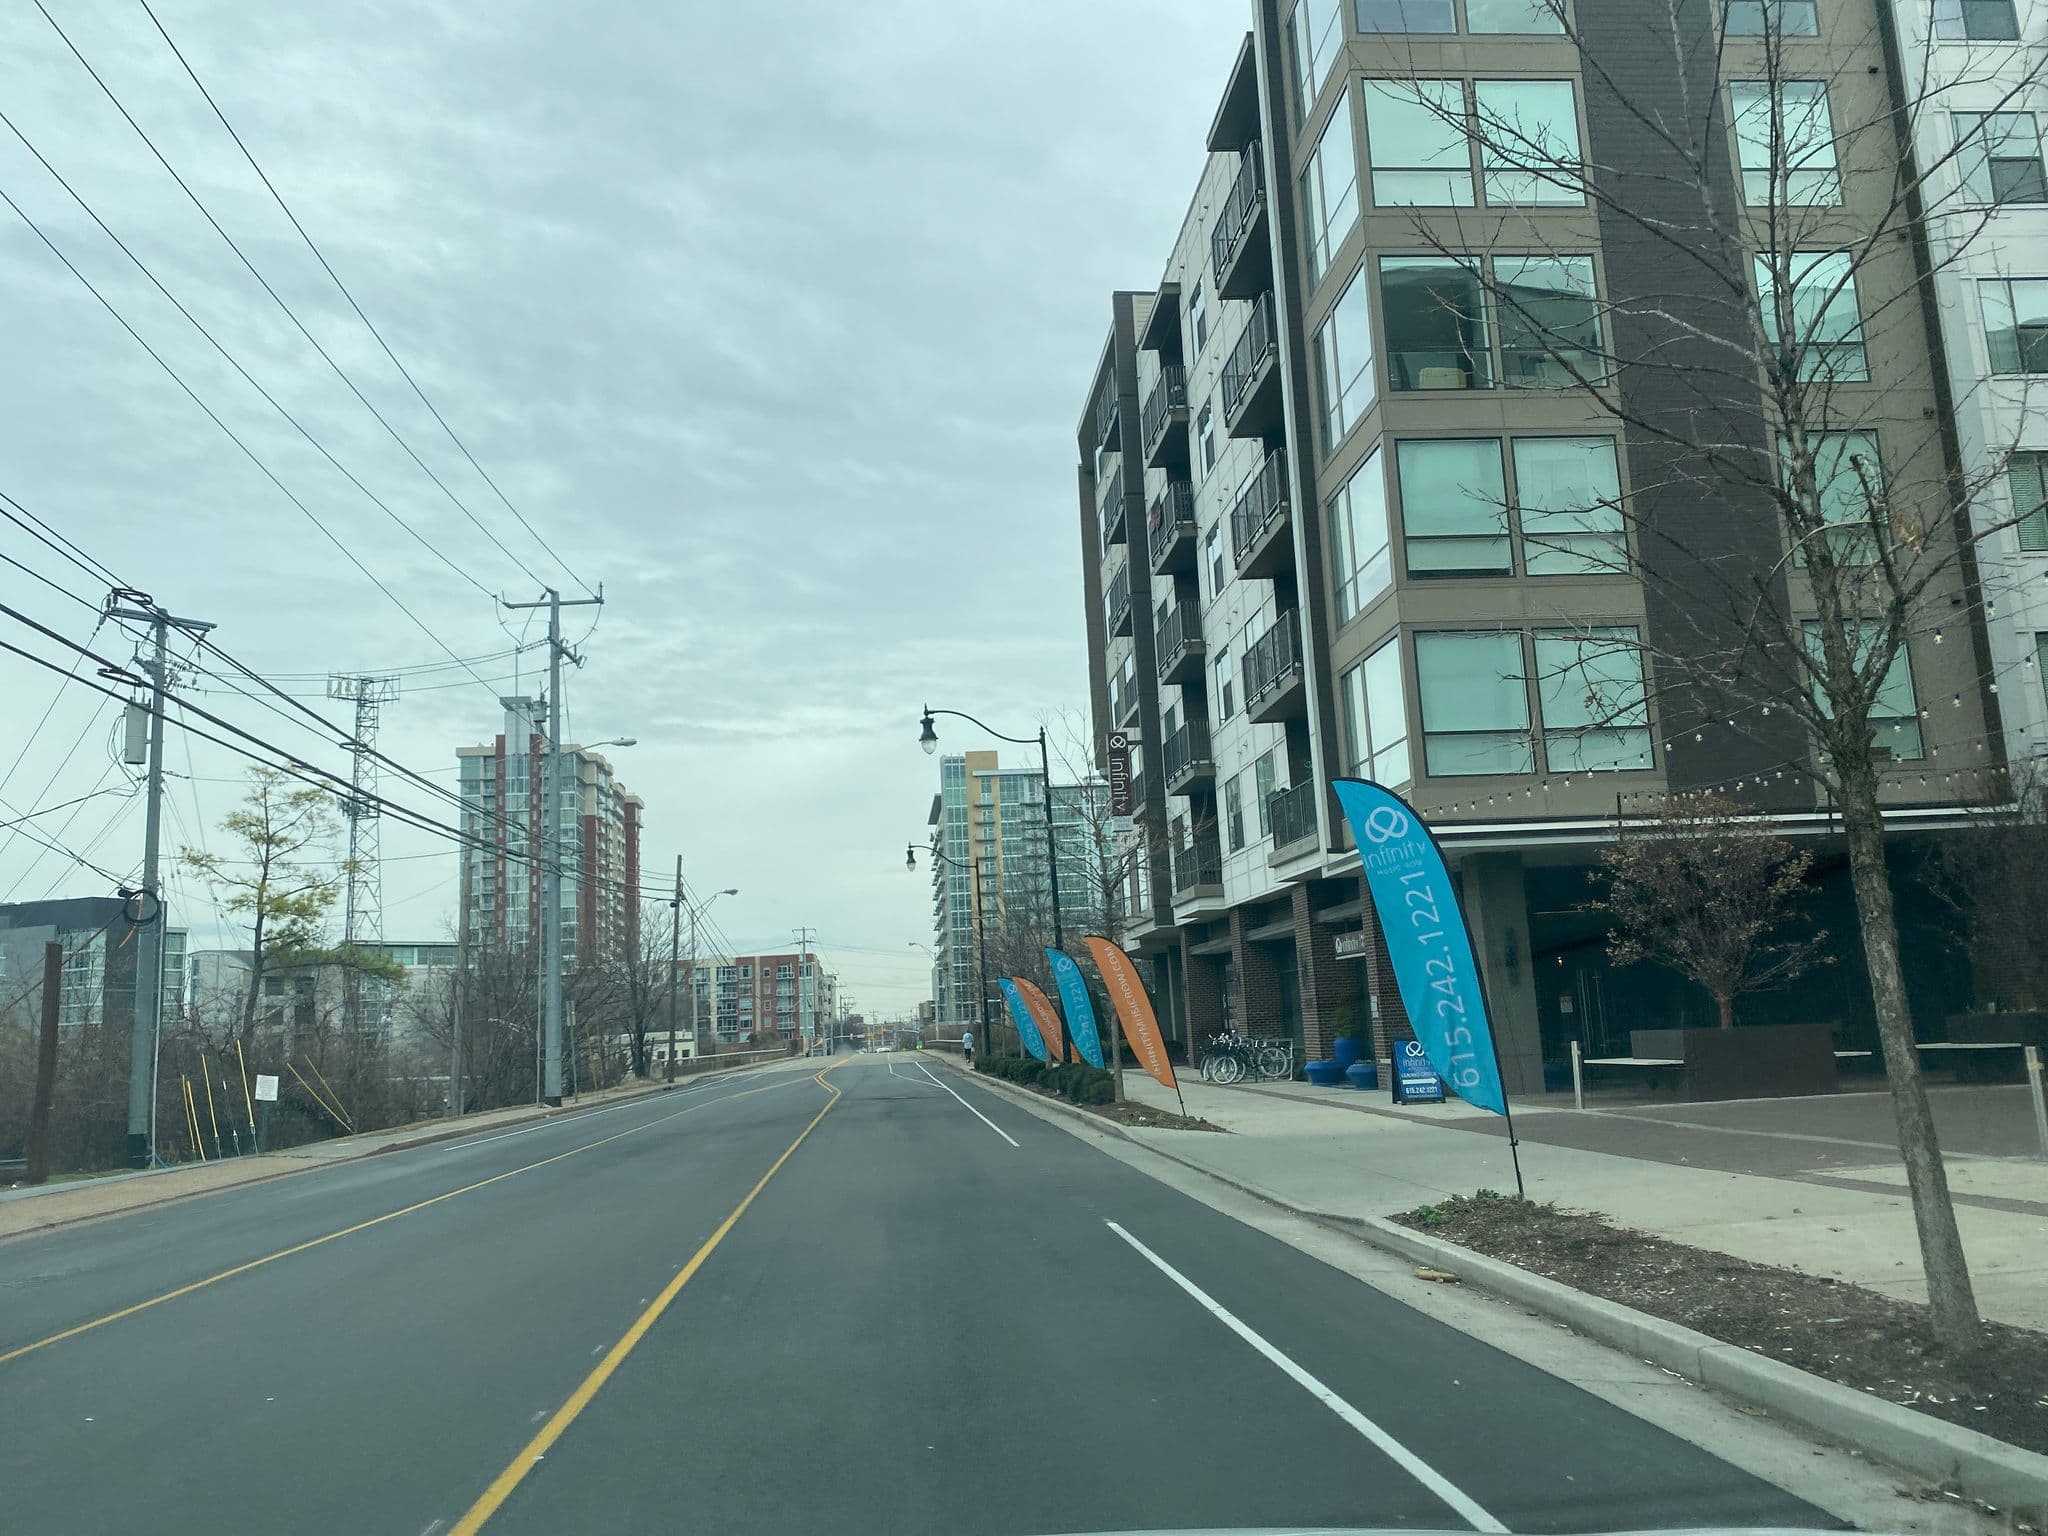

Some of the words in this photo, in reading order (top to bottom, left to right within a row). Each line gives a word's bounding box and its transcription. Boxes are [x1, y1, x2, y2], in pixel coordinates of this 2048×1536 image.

[1111, 757, 1129, 812] infinity
[1363, 840, 1426, 870] infinity
[1399, 870, 1482, 1088] 615.242.1221
